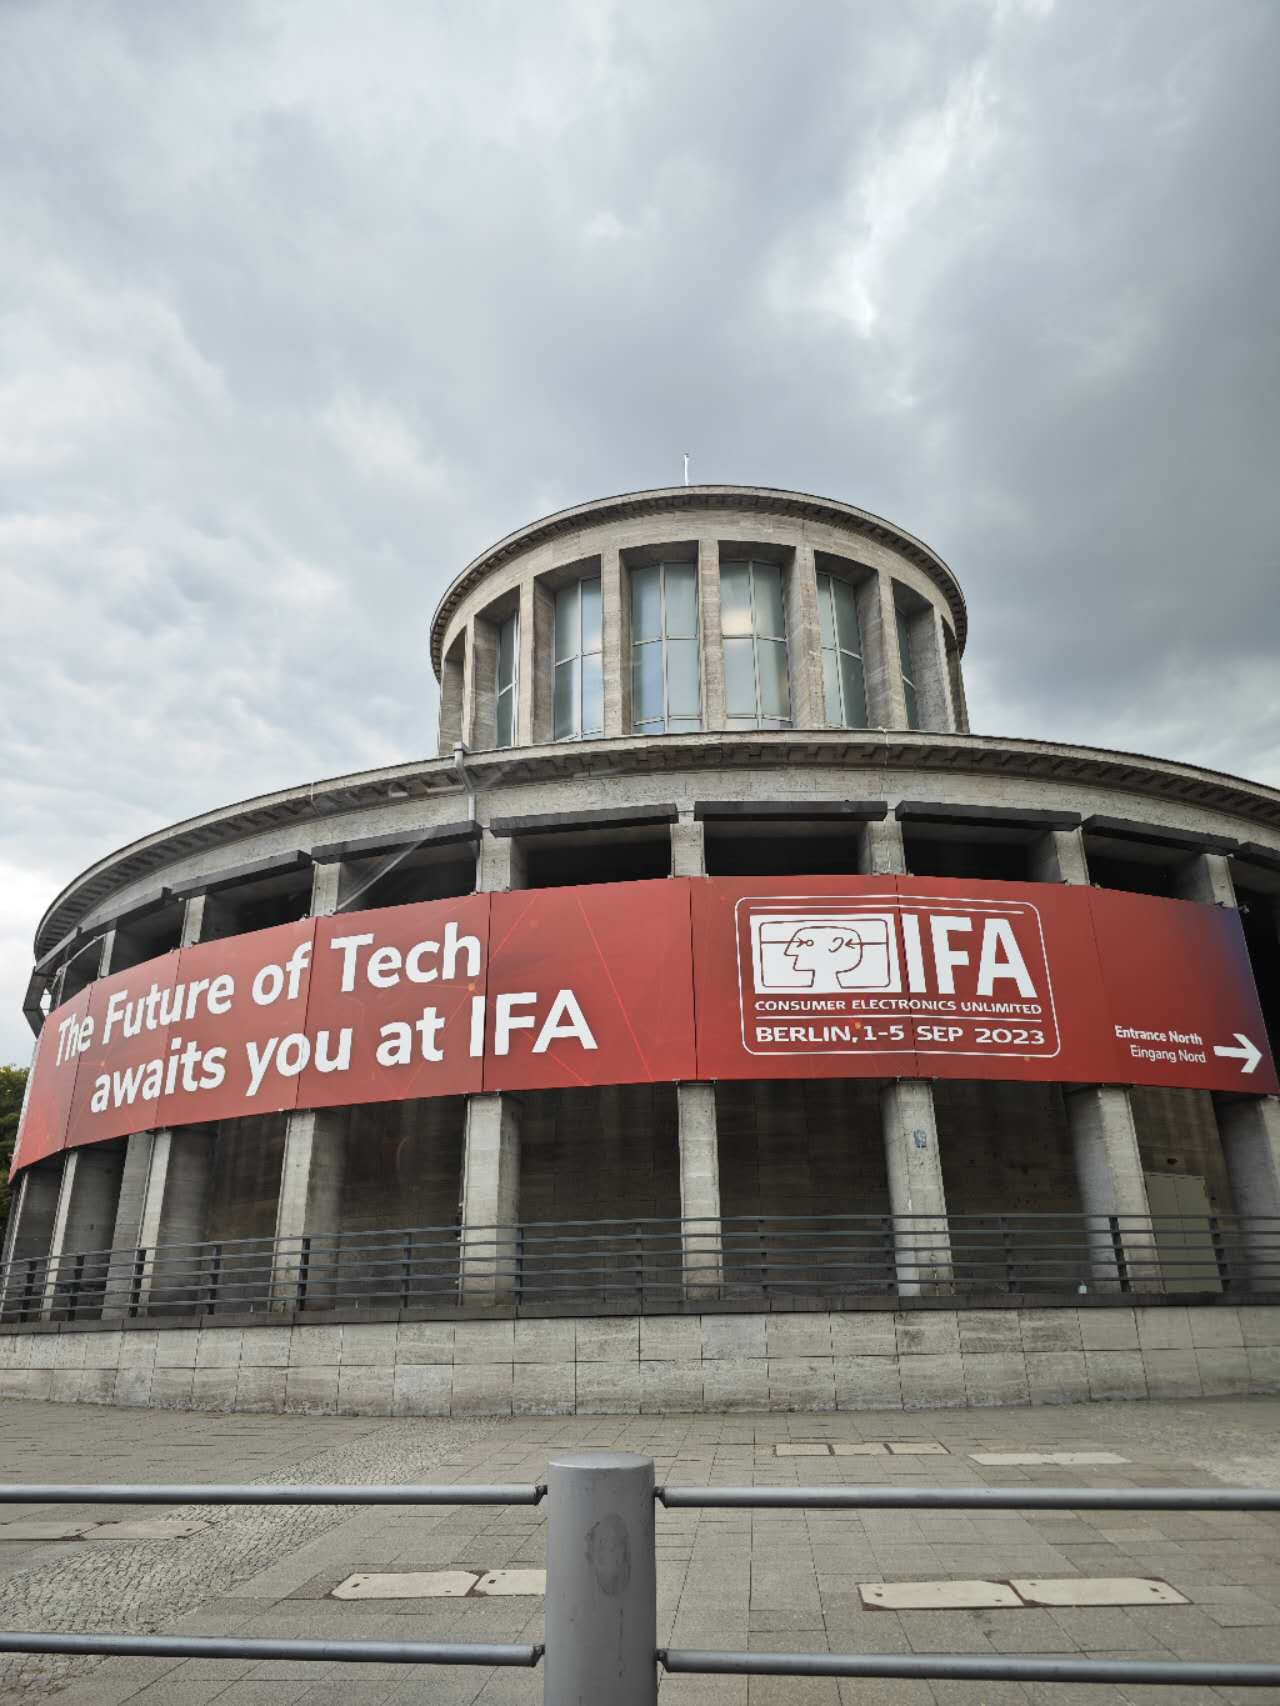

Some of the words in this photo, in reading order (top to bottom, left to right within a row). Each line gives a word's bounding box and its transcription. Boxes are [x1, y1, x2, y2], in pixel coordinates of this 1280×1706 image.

[902, 913, 1038, 999] IFA
[55, 1014, 94, 1067] The
[102, 974, 235, 1045] Future
[251, 941, 313, 1006] of
[331, 922, 481, 992] Tech
[755, 1000, 845, 1011] CONSUMER
[851, 999, 956, 1011] ELECTRONICS
[961, 1002, 1042, 1015] UNLIMITED
[755, 1025, 859, 1043] BERLIN,
[864, 1025, 905, 1041] 1-5
[917, 1025, 964, 1042] SEP
[974, 1028, 1046, 1045] 2023
[1114, 1024, 1167, 1042] Entrance
[1169, 1031, 1204, 1046] North
[91, 1037, 225, 1113] awaits
[245, 1028, 352, 1097] you
[375, 1007, 445, 1067] at
[469, 989, 598, 1057] IFA
[1130, 1045, 1177, 1063] Eingang
[1178, 1050, 1207, 1064] Nord
